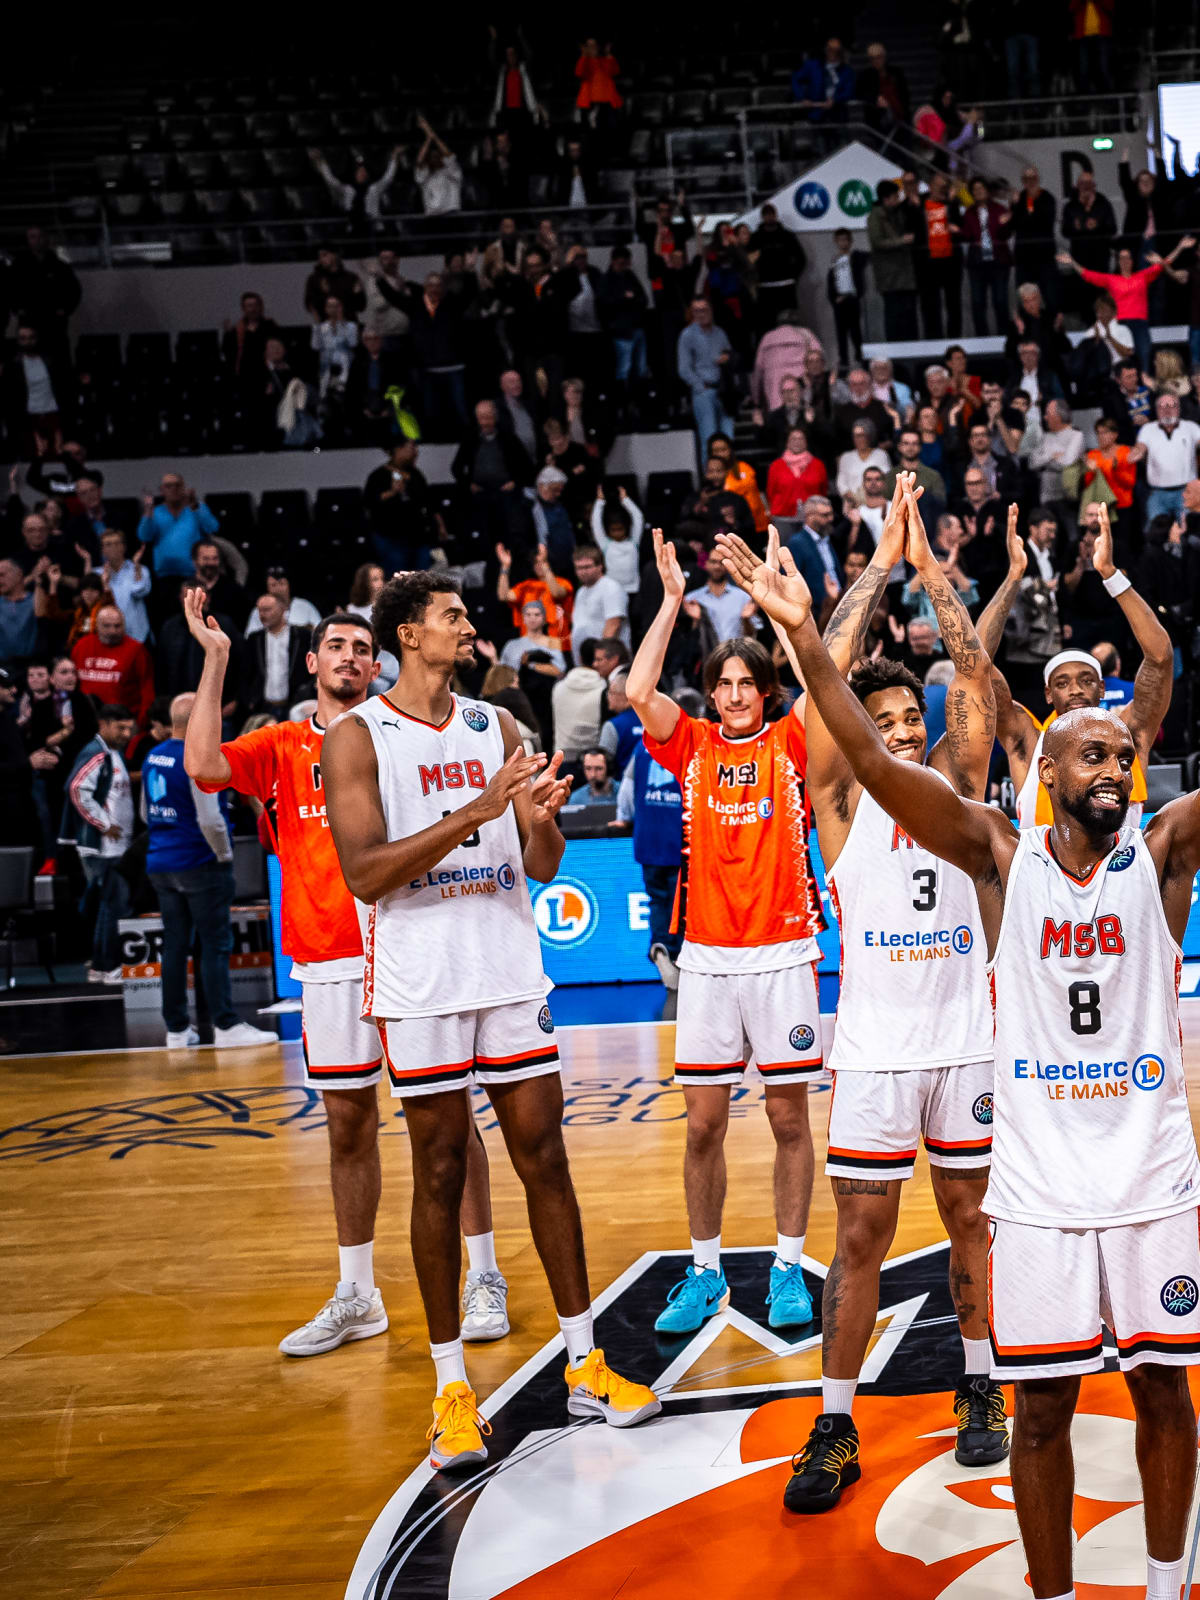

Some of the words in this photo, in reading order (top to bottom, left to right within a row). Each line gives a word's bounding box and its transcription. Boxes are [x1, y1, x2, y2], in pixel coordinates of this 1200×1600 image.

[418, 759, 488, 796] MSB
[440, 887, 457, 899] LE
[461, 881, 497, 897] MANS
[912, 869, 937, 911] 3
[864, 930, 950, 946] E.Leclerc
[1040, 913, 1126, 960] MSB
[890, 949, 905, 962] LE
[909, 945, 951, 962] MANS
[1068, 980, 1102, 1035] 8
[1014, 1059, 1129, 1080] E.Leclerc
[1047, 1084, 1065, 1100] LE
[1071, 1080, 1129, 1100] MANS
